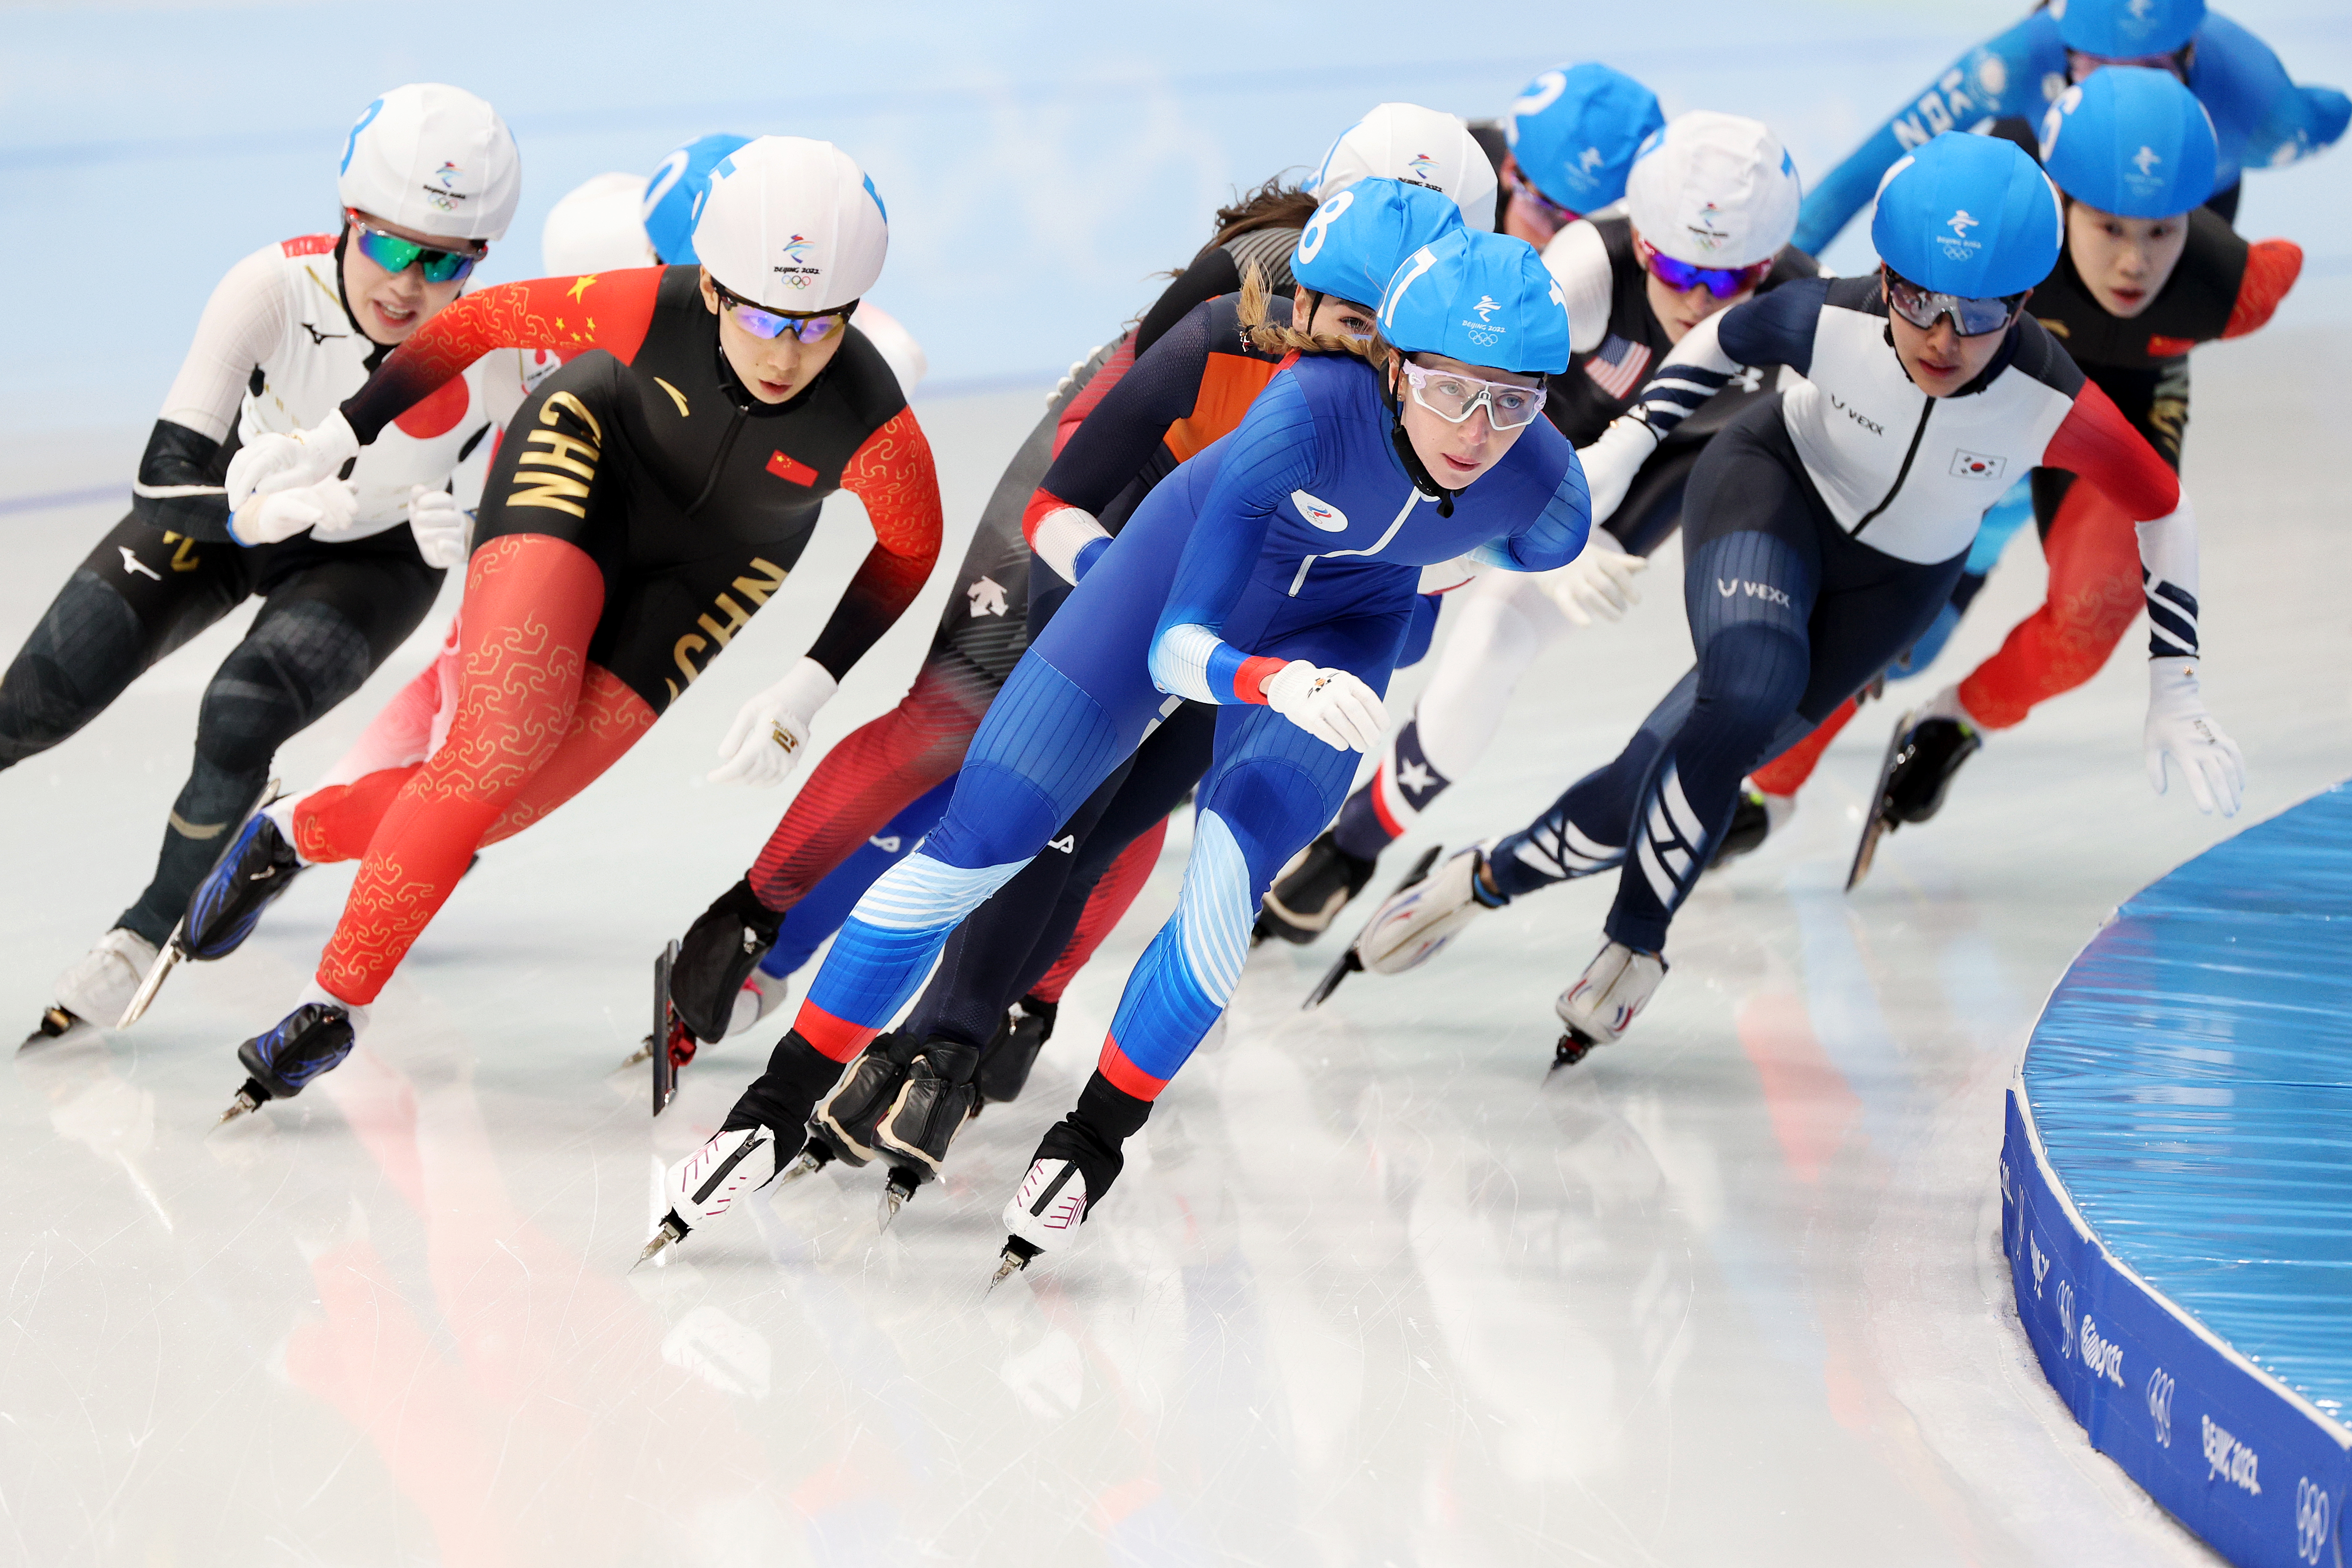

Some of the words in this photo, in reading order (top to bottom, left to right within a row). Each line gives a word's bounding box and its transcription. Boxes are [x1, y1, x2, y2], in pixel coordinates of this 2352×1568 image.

[1298, 190, 1354, 264] 8
[1462, 320, 1487, 330] BEIJING
[506, 390, 602, 519] CHN
